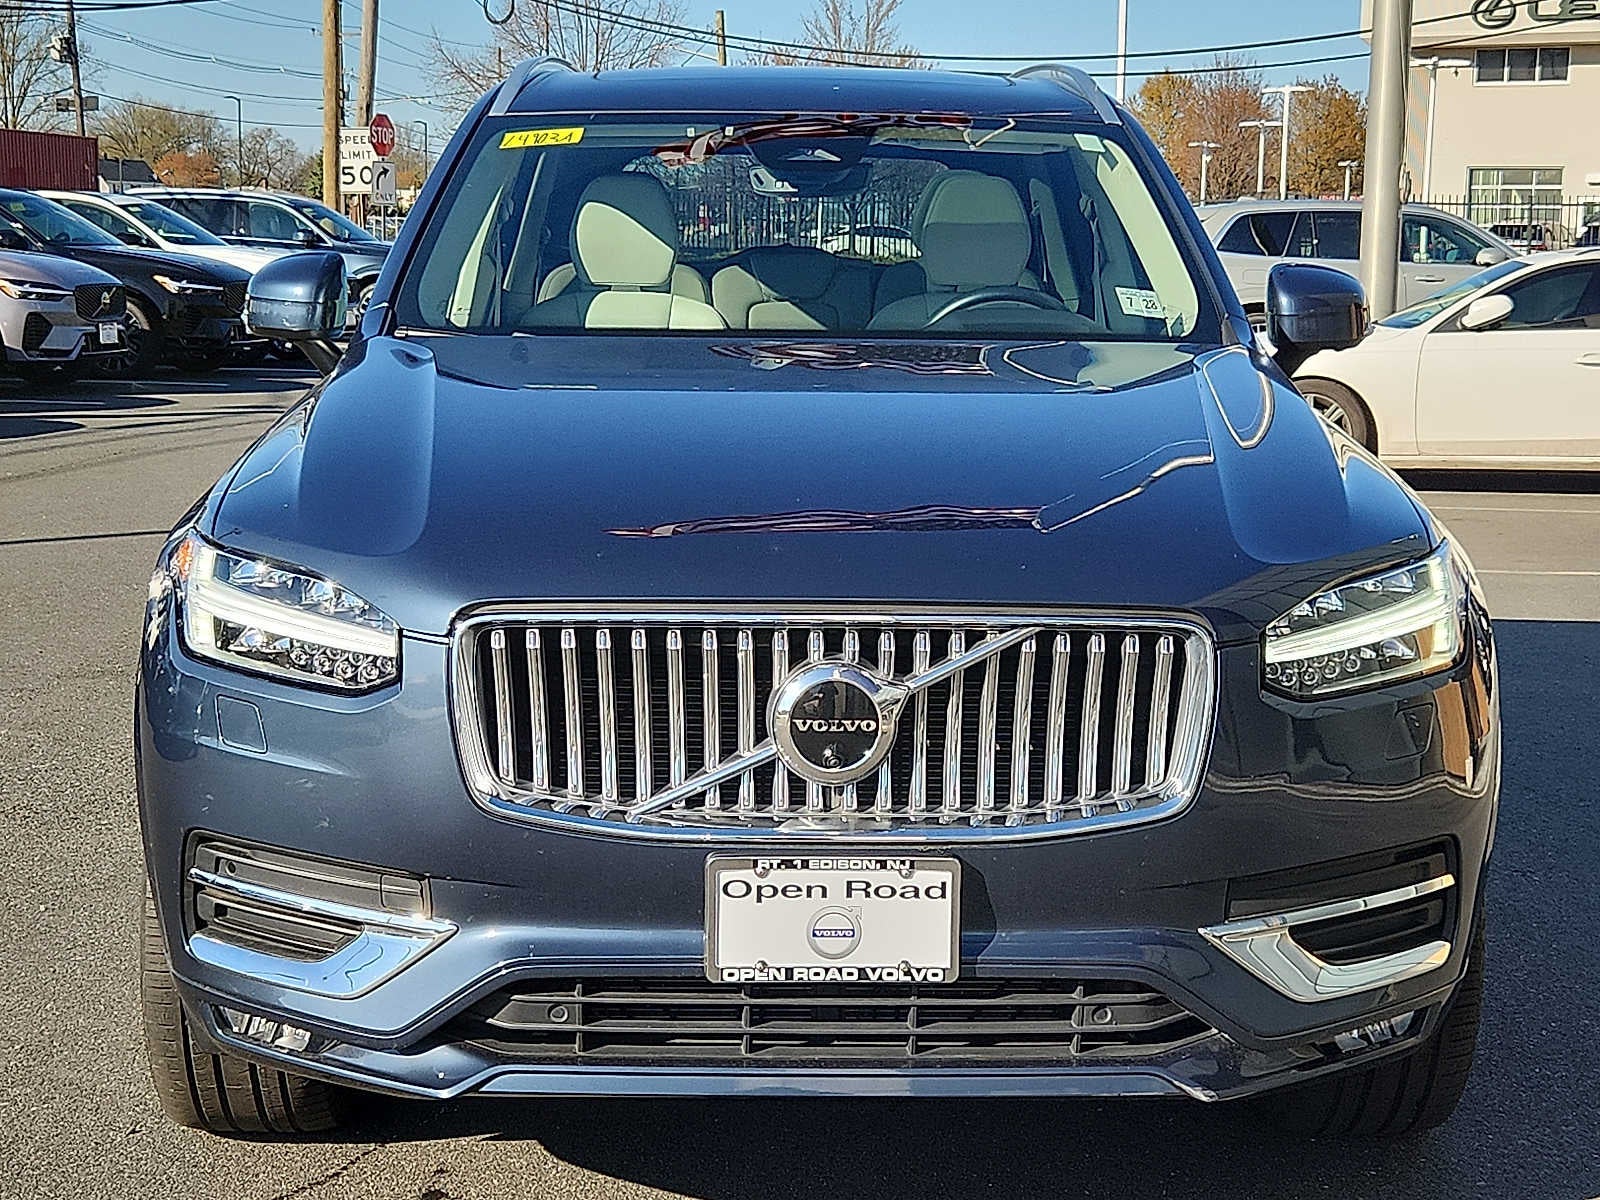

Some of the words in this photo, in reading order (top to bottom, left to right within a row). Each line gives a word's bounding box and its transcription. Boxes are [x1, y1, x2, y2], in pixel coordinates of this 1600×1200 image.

[371, 126, 394, 145] STOP
[341, 150, 372, 160] LIMIT
[342, 166, 373, 185] 50
[375, 192, 394, 202] ONLY
[1125, 296, 1133, 308] 7
[792, 719, 877, 732] VOLVO
[794, 859, 803, 870] 1
[886, 859, 912, 870] NJ
[721, 879, 828, 904] Open
[845, 880, 947, 900] Road
[814, 929, 854, 937] VOLVO
[721, 967, 787, 982] OPEN
[792, 967, 859, 982] ROAD
[861, 967, 944, 982] VOLVO
